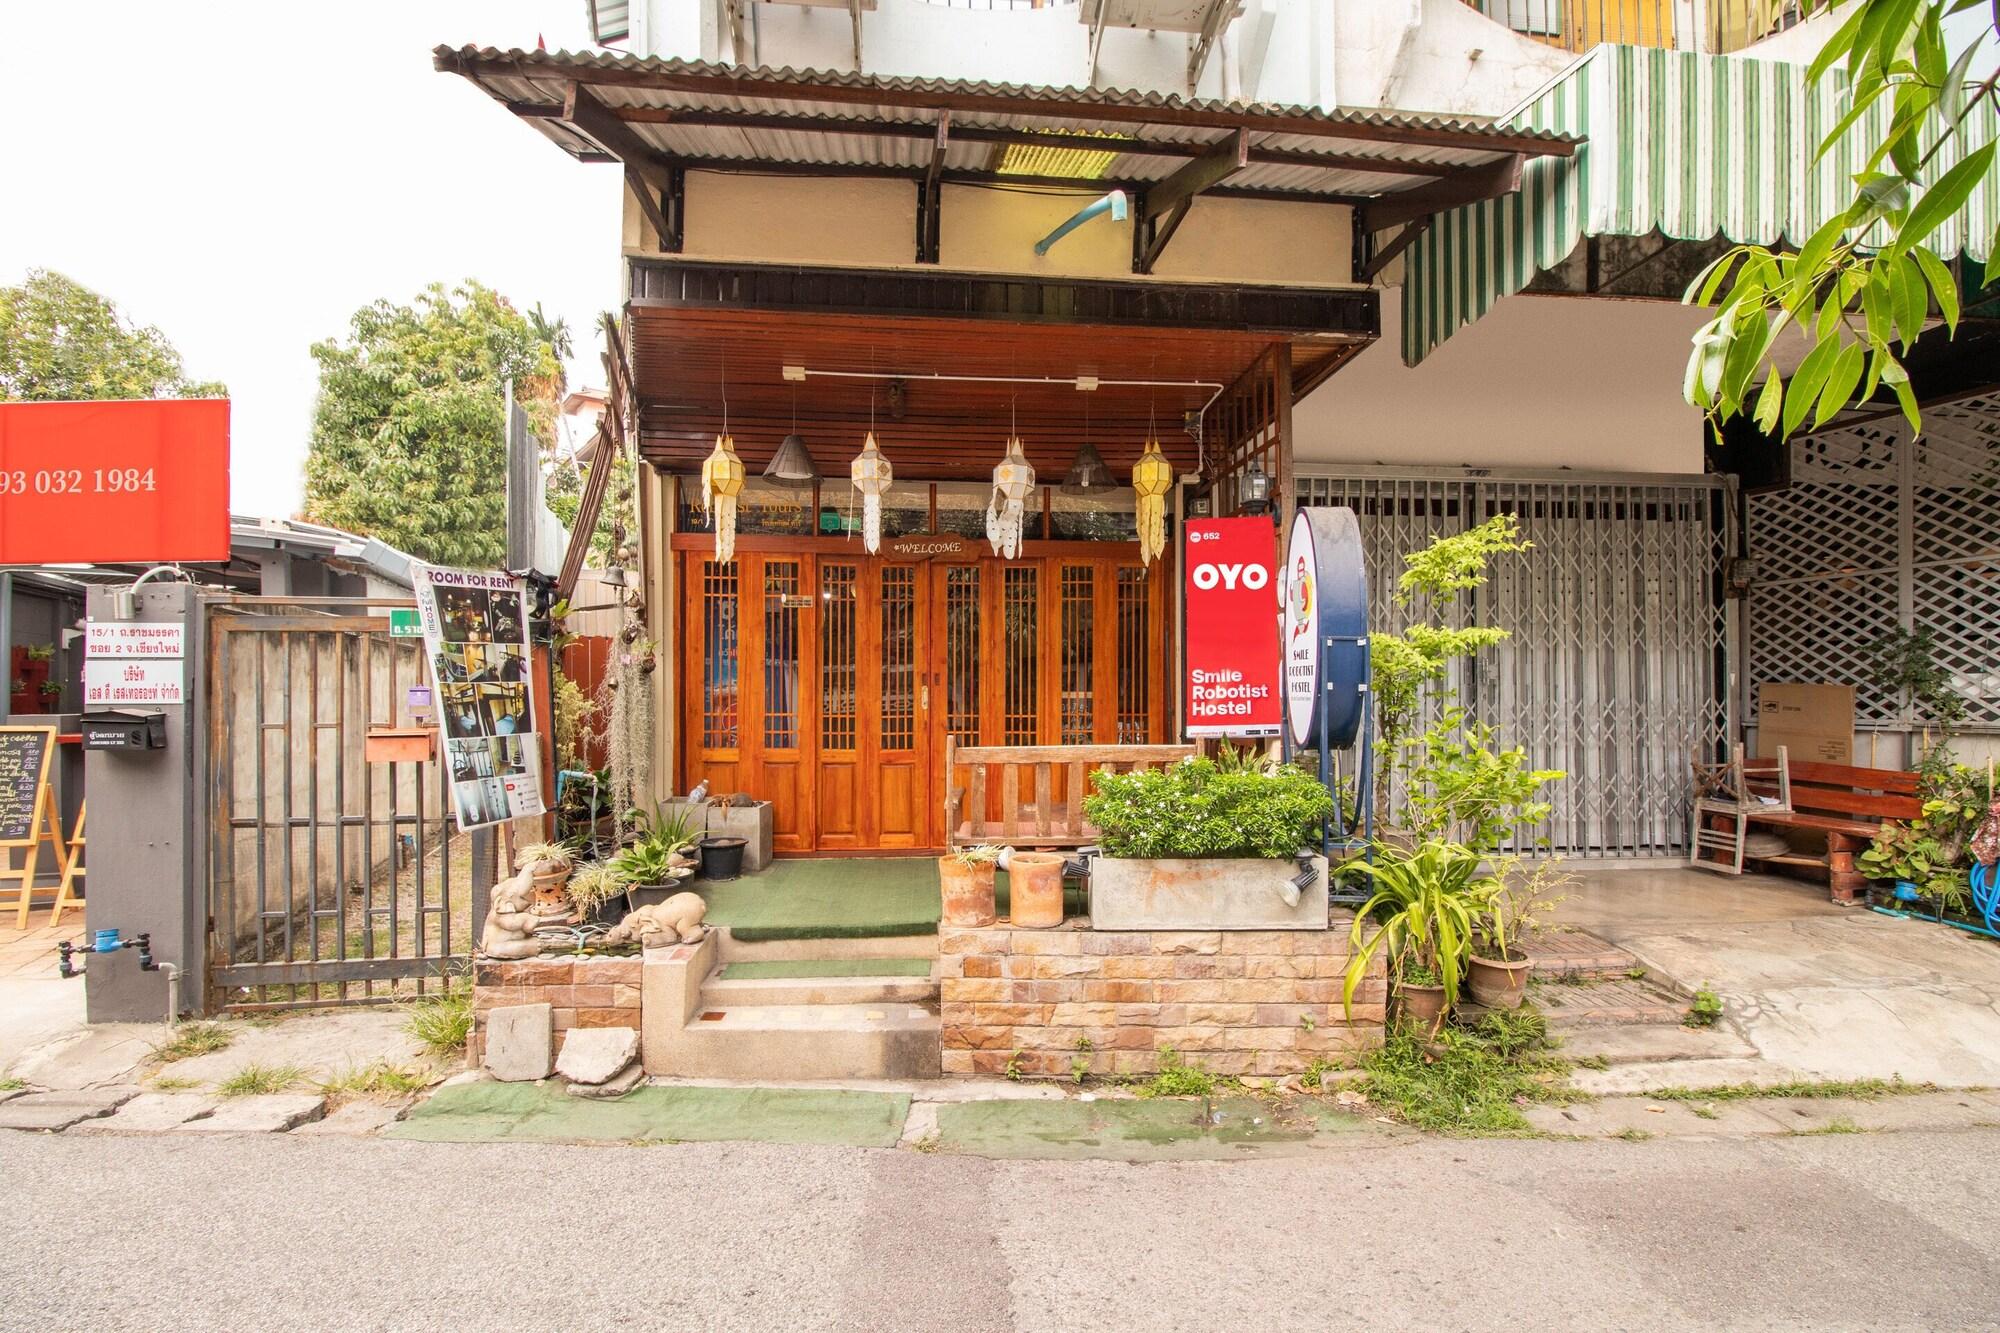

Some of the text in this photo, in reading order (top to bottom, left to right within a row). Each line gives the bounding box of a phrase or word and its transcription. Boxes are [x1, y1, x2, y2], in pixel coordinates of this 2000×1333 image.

[34, 470, 83, 493] 032
[93, 468, 156, 492] 1984
[1203, 532, 1220, 540] 652
[427, 571, 515, 589] ROOM FOR RENT
[1193, 563, 1268, 590] OYO
[91, 629, 114, 637] 15/1
[115, 645, 121, 653] 2
[123, 665, 145, 681] บริษัท
[1192, 669, 1243, 683] Smile
[1192, 684, 1269, 700] Robotist
[1192, 700, 1252, 716] Hostel
